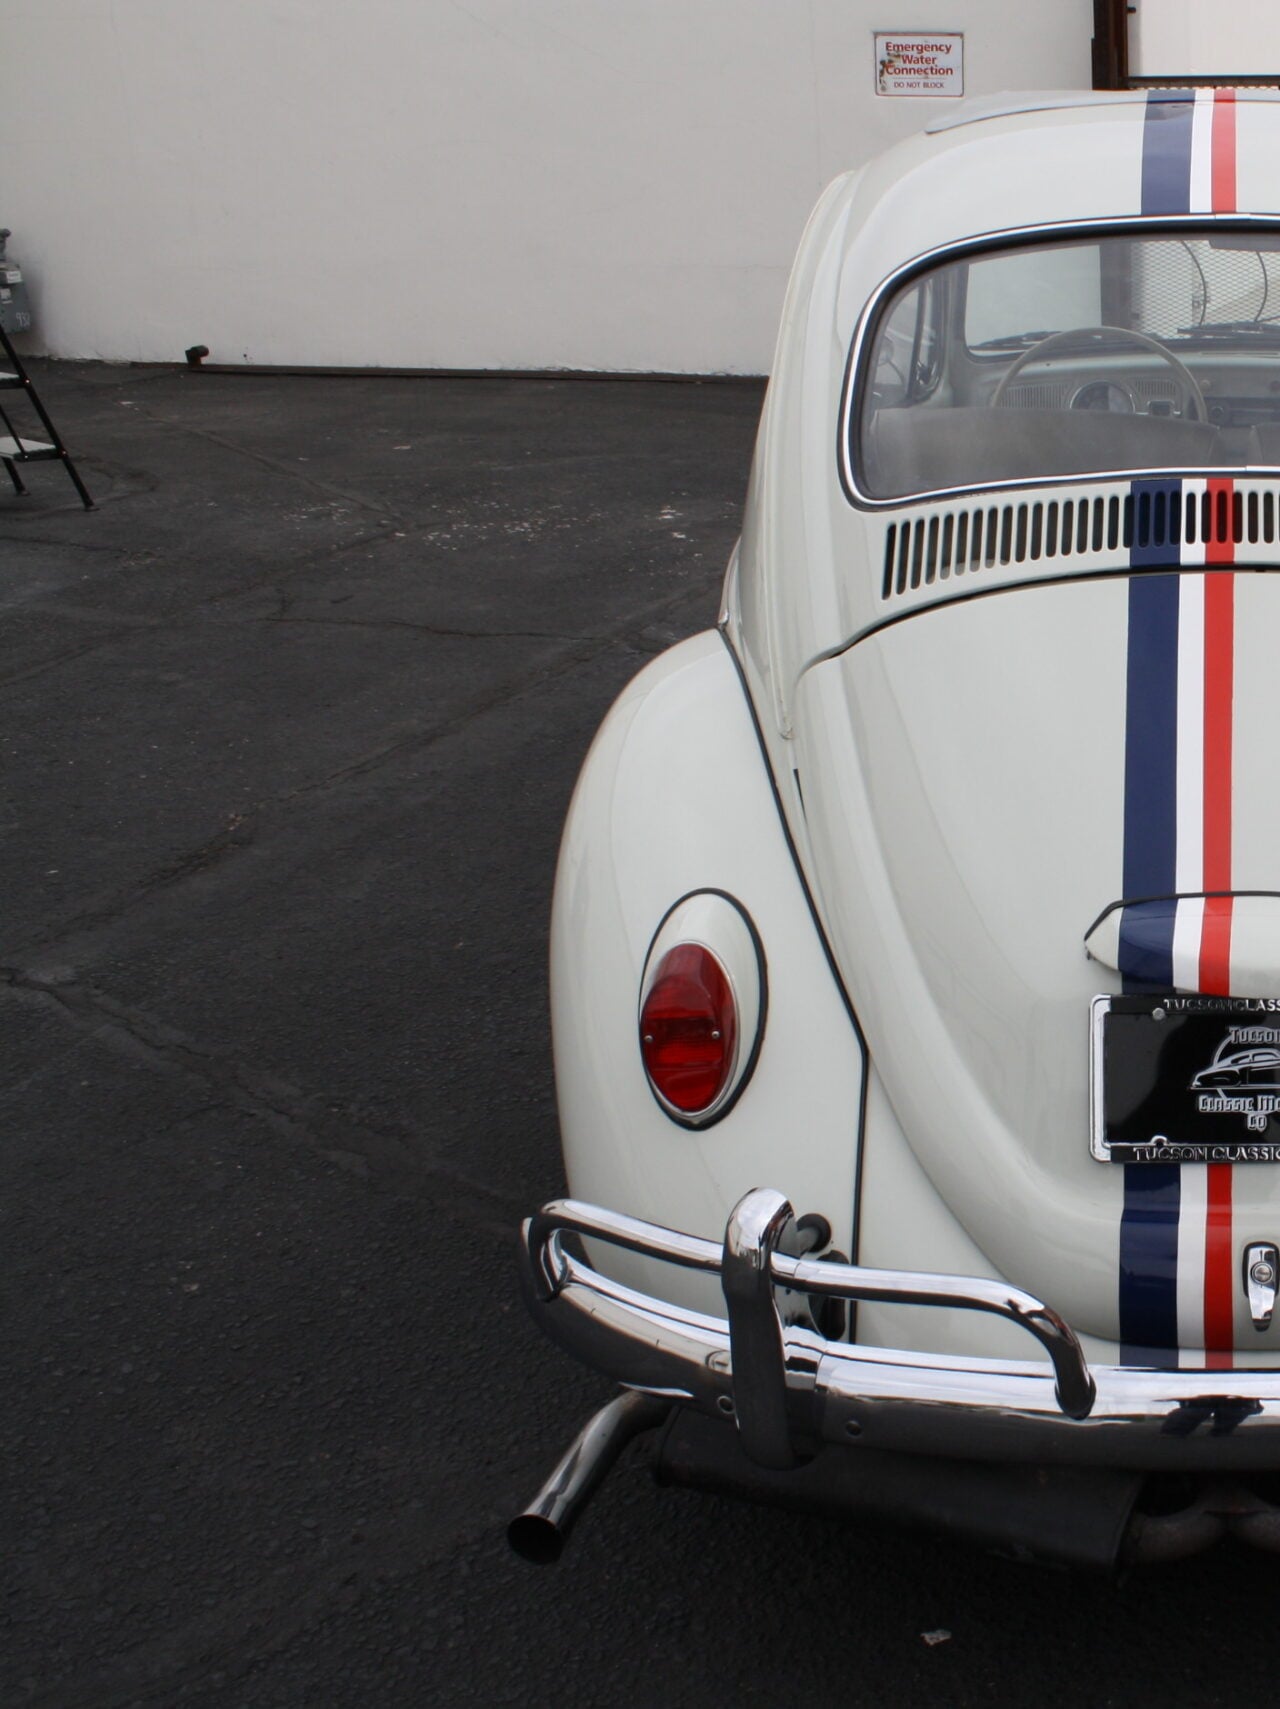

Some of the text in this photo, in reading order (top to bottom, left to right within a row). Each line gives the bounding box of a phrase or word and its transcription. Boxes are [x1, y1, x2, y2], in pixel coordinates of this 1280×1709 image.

[885, 41, 952, 54] Emergency
[901, 54, 937, 65] Water
[886, 65, 953, 75] Connection
[1133, 1146, 1207, 1160] TUCSON
